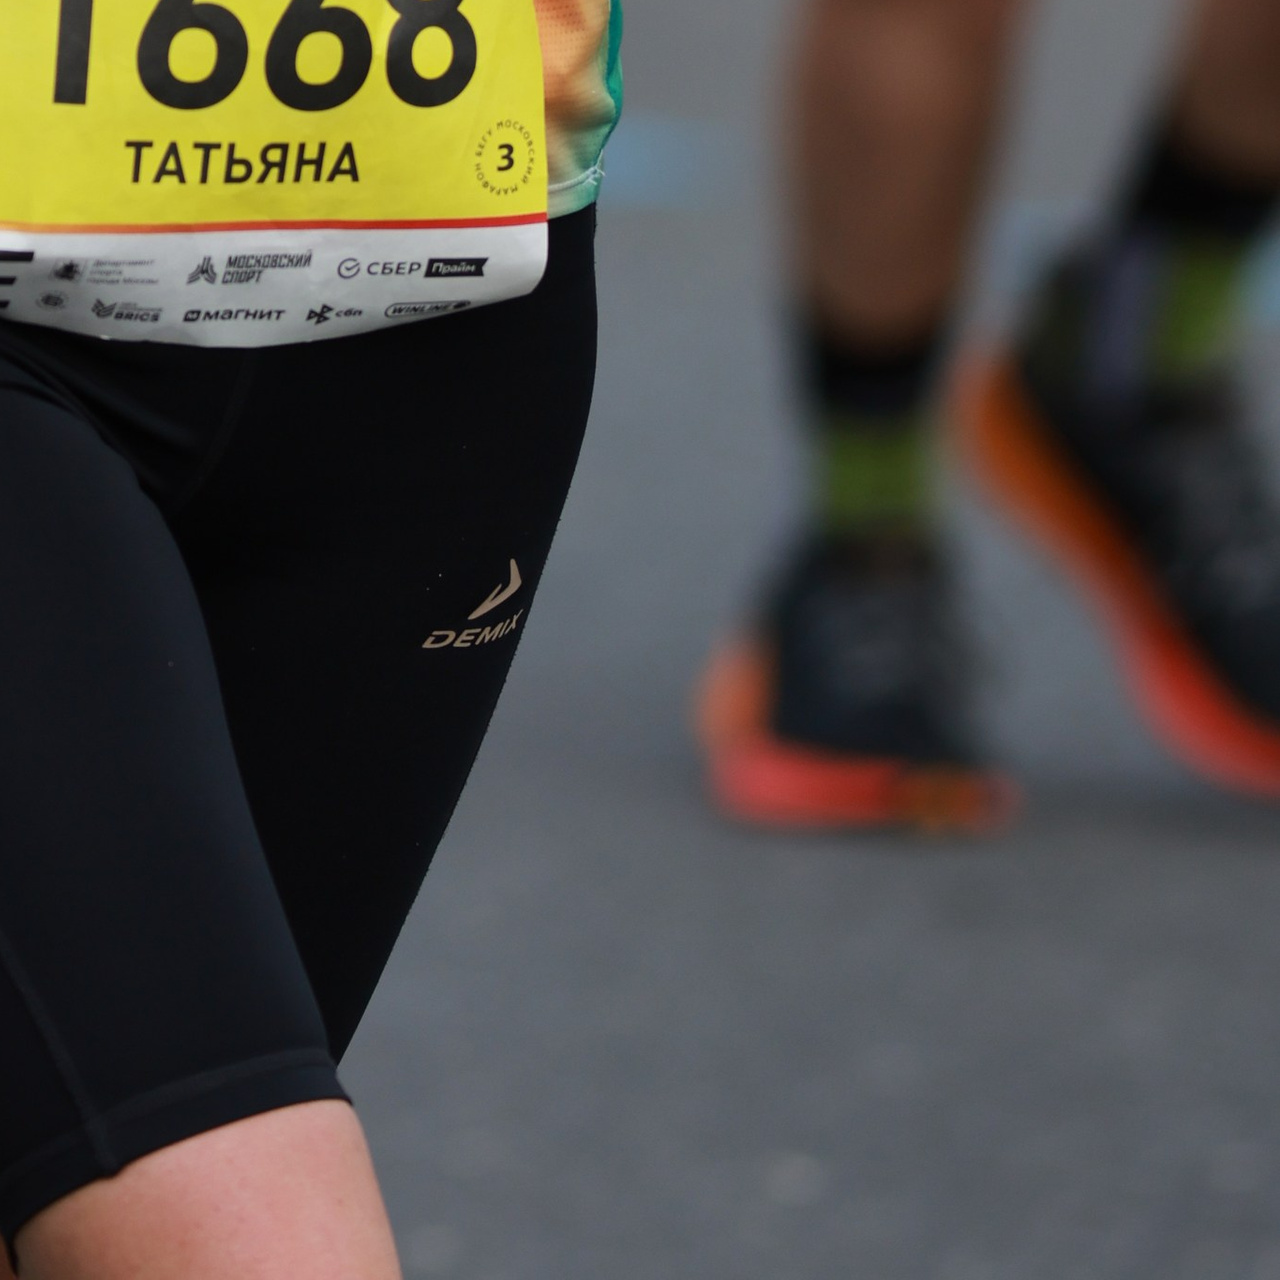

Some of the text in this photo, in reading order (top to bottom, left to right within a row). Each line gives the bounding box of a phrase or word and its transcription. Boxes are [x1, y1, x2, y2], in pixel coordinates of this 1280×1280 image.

[124, 141, 361, 185] ТАТЬЯНА
[496, 143, 515, 172] 3
[225, 249, 313, 269] МОСКОВСКИЙ
[367, 261, 476, 276] СБЕР Прайм
[222, 270, 265, 284] СПОРТ
[422, 609, 523, 648] DEMIX
